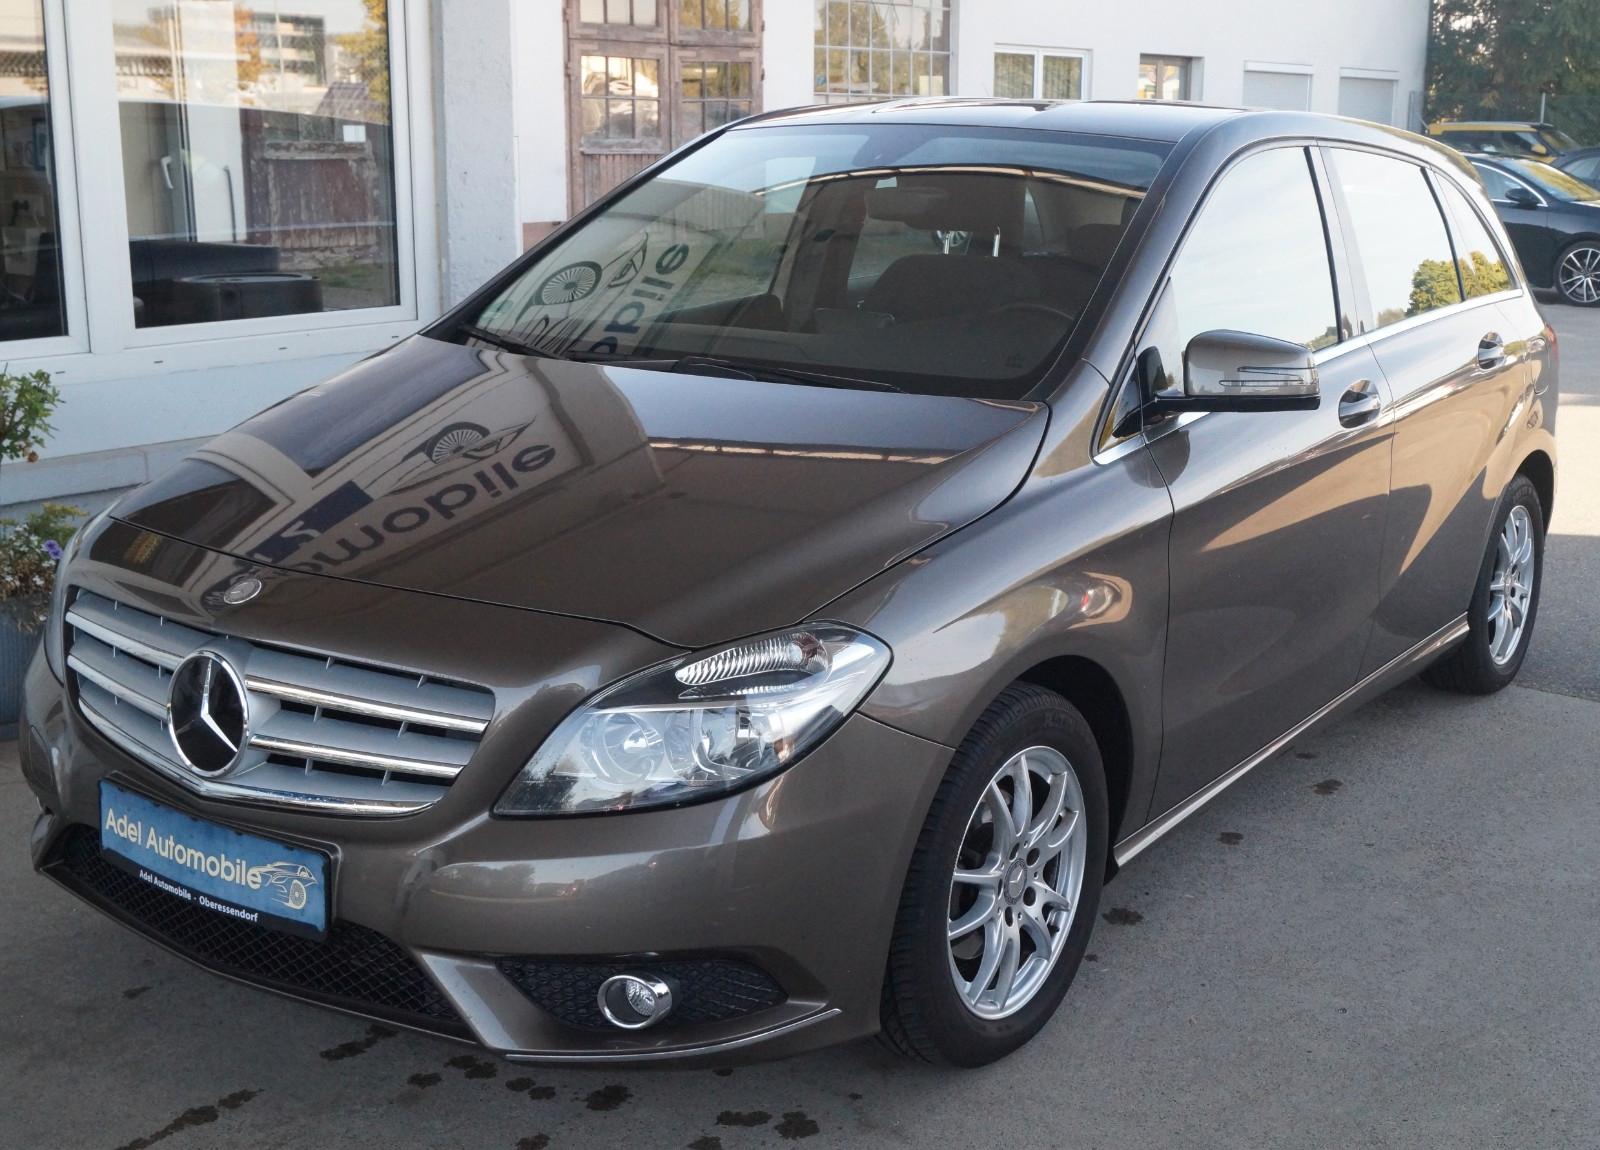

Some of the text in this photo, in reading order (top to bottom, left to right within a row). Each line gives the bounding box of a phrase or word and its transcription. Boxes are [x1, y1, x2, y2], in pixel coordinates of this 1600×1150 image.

[105, 808, 262, 889] Adel Automobile
[139, 869, 154, 883] Adel
[153, 879, 192, 901] Automobile
[199, 895, 259, 922] Oberessendorf
